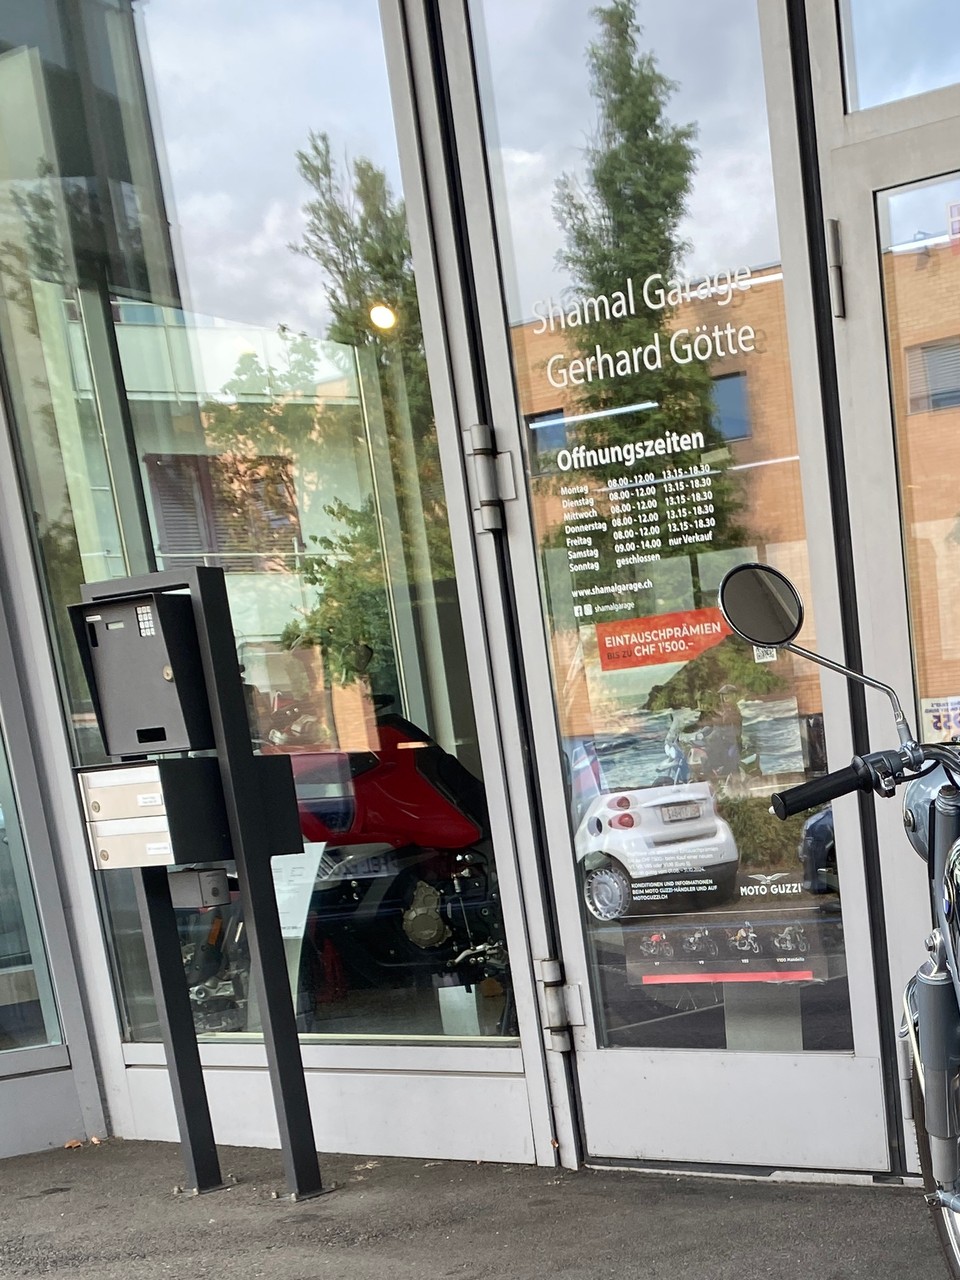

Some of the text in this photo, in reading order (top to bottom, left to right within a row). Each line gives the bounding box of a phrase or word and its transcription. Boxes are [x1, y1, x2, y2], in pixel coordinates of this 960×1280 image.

[532, 265, 752, 335] Shamal Garage
[547, 322, 754, 388] Gerhard Götte
[560, 484, 589, 496] Montag
[562, 496, 594, 508] Dienstag
[564, 509, 597, 521] Mittwoch
[565, 521, 607, 534] Donnerstag
[566, 536, 592, 547] Freitag
[568, 549, 599, 560] Samstag
[669, 537, 681, 546] nur
[683, 533, 713, 544] Verkauf
[569, 553, 661, 572] Sonntag geschlossen
[572, 579, 653, 598] www.shamalgarage.ch
[594, 601, 635, 613] shamalgarage
[605, 622, 721, 647] EINTAUSCHPRÄMIEN
[607, 652, 620, 660] BIS
[622, 651, 632, 659] ZU
[634, 645, 656, 657] CHF
[740, 883, 801, 896] MOTO GUZZI
